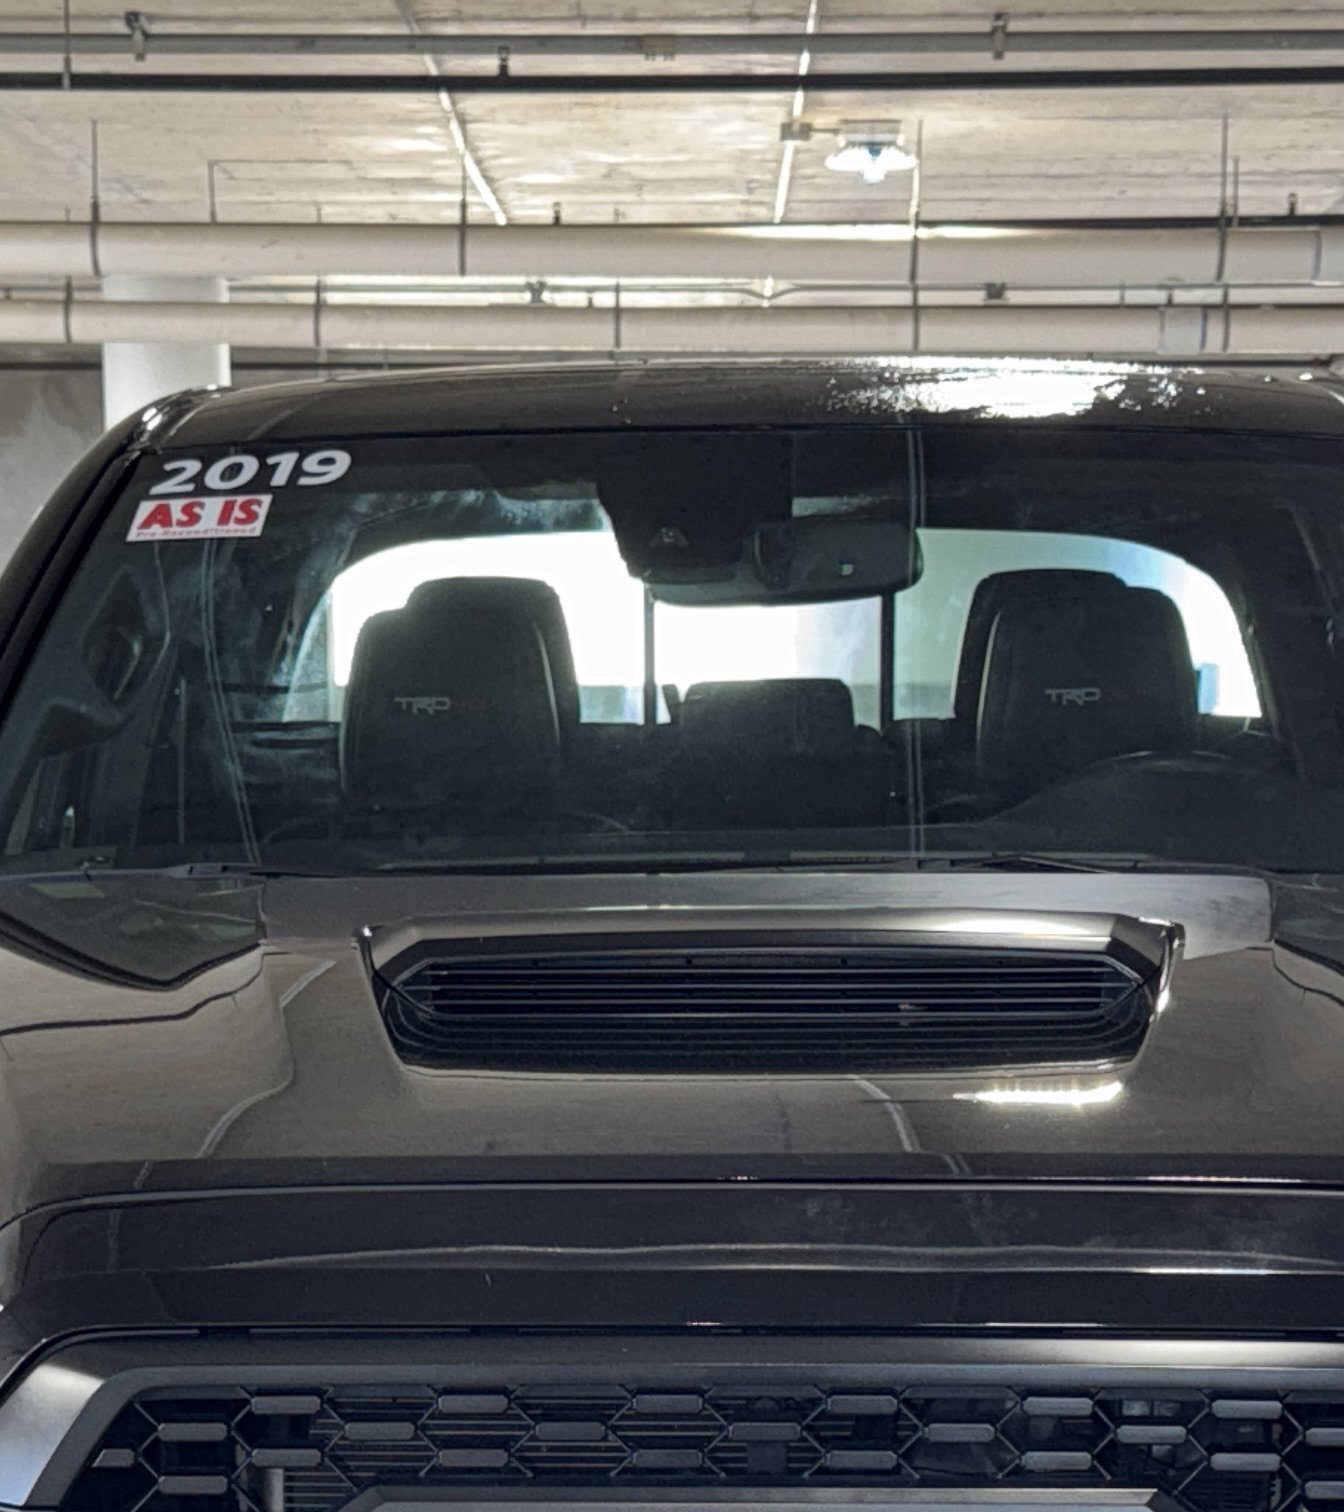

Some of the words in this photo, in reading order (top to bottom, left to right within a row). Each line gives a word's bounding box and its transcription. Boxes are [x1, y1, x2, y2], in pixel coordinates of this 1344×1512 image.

[149, 450, 352, 495] 2019
[137, 501, 205, 529] AS
[217, 498, 263, 526] IS
[393, 696, 451, 715] TRD
[1044, 687, 1101, 706] TRD
